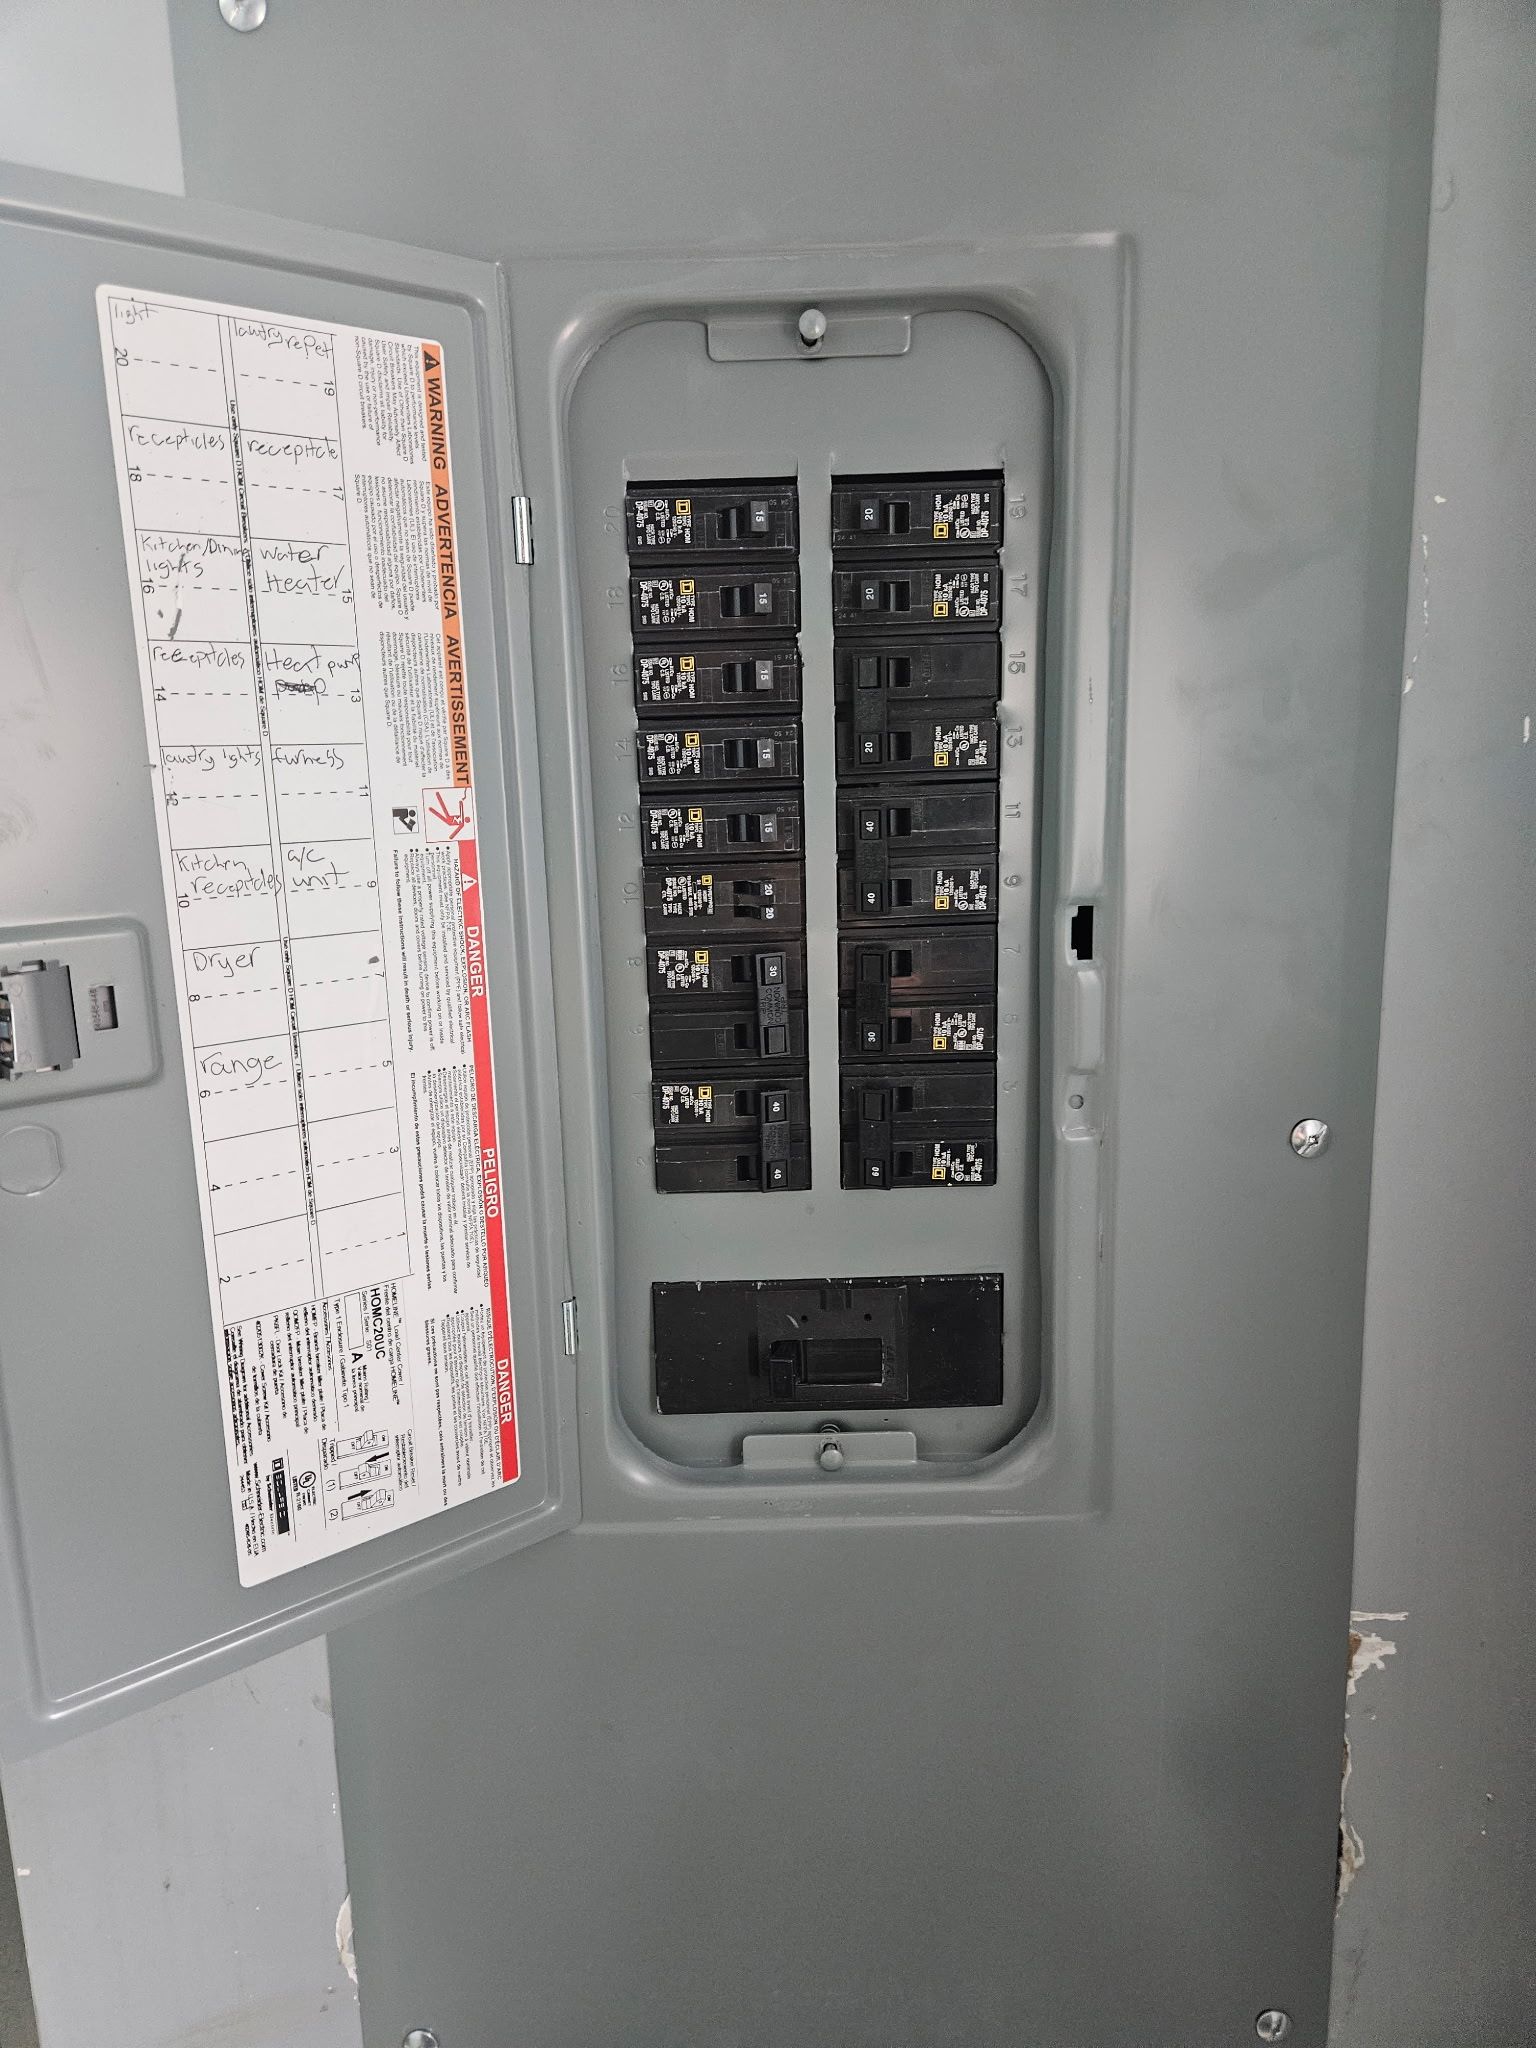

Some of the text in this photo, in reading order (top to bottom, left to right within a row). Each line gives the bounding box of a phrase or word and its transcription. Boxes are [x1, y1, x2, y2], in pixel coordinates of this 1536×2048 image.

[114, 303, 159, 325] light
[114, 347, 129, 367] 20
[323, 380, 335, 397] 19
[427, 377, 447, 470] WARNING
[127, 465, 142, 482] 18
[332, 486, 344, 501] 17
[635, 501, 644, 528] DP-4075
[755, 510, 764, 522] 15
[864, 508, 873, 520] 20
[980, 510, 990, 538] DP-4075
[434, 483, 457, 620] ADVERTENCIA
[146, 553, 204, 579] lights
[141, 578, 155, 594] 16
[266, 564, 345, 593] Heater
[341, 588, 353, 604] 15
[639, 581, 649, 608] DP-4075
[759, 592, 768, 604] 15
[865, 588, 874, 600] 20
[980, 589, 989, 616] DP-4075
[266, 645, 321, 673] Heat
[1007, 650, 1026, 674] 15
[640, 658, 650, 685] DP-4075
[760, 669, 769, 680] 15
[154, 686, 167, 702] 14
[350, 688, 361, 703] 13
[447, 635, 469, 784] AVERTISSEMENT
[645, 734, 655, 760] DP-4075
[762, 748, 771, 759] 15
[864, 741, 873, 753] 20
[979, 739, 987, 765] DP-4075
[165, 791, 178, 807] 12
[359, 784, 369, 798] 11
[649, 809, 658, 835] DP-4075
[764, 821, 773, 833] 15
[865, 820, 874, 832] 40
[292, 861, 350, 887] unit
[366, 881, 377, 889] 9
[764, 884, 773, 896] 20
[177, 892, 190, 908] 10
[867, 892, 875, 904] 40
[979, 884, 987, 910] DP-4075
[765, 907, 774, 920] 20
[398, 915, 406, 950] instructions
[192, 946, 261, 978] Dryer
[466, 926, 484, 998] DANGER
[657, 950, 666, 974] DP-4075
[376, 970, 385, 978] 7
[769, 965, 777, 977] 30
[188, 993, 201, 1003] 8
[867, 1031, 876, 1043] 30
[976, 1027, 984, 1051] DP-4075
[199, 1051, 283, 1086] range
[382, 1060, 392, 1068] 5
[199, 1089, 211, 1099] 6
[772, 1101, 781, 1112] 40
[389, 1146, 399, 1154] 3
[773, 1168, 782, 1180] 40
[871, 1166, 880, 1177] 60
[210, 1183, 221, 1192] 4
[483, 1148, 499, 1218] PELIGRO
[219, 1275, 231, 1284] 2
[370, 1288, 386, 1360] HOMC20UC
[394, 1324, 402, 1341] Load
[351, 1352, 364, 1364] A
[497, 1358, 512, 1424] DANGER
[325, 1479, 337, 1491] (1)
[328, 1508, 339, 1521] (2)
